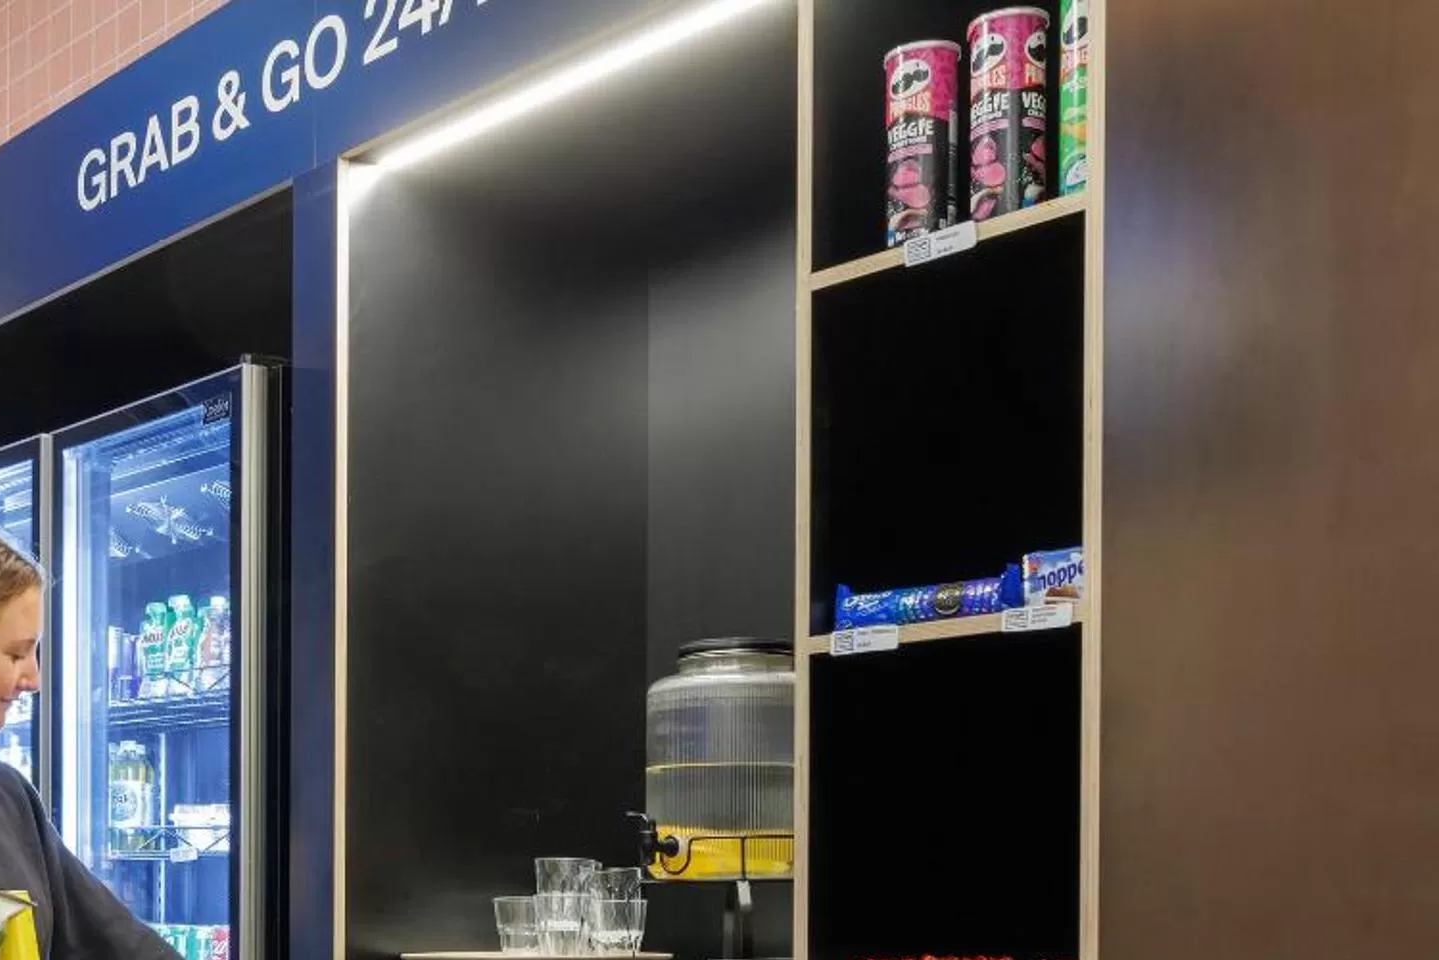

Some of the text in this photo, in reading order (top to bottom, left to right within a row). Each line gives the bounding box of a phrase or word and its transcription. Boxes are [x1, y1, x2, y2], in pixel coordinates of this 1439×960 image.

[76, 94, 200, 212] GRAB
[212, 69, 251, 141] &
[262, 14, 348, 113] GO
[971, 92, 1010, 121] EGGIE
